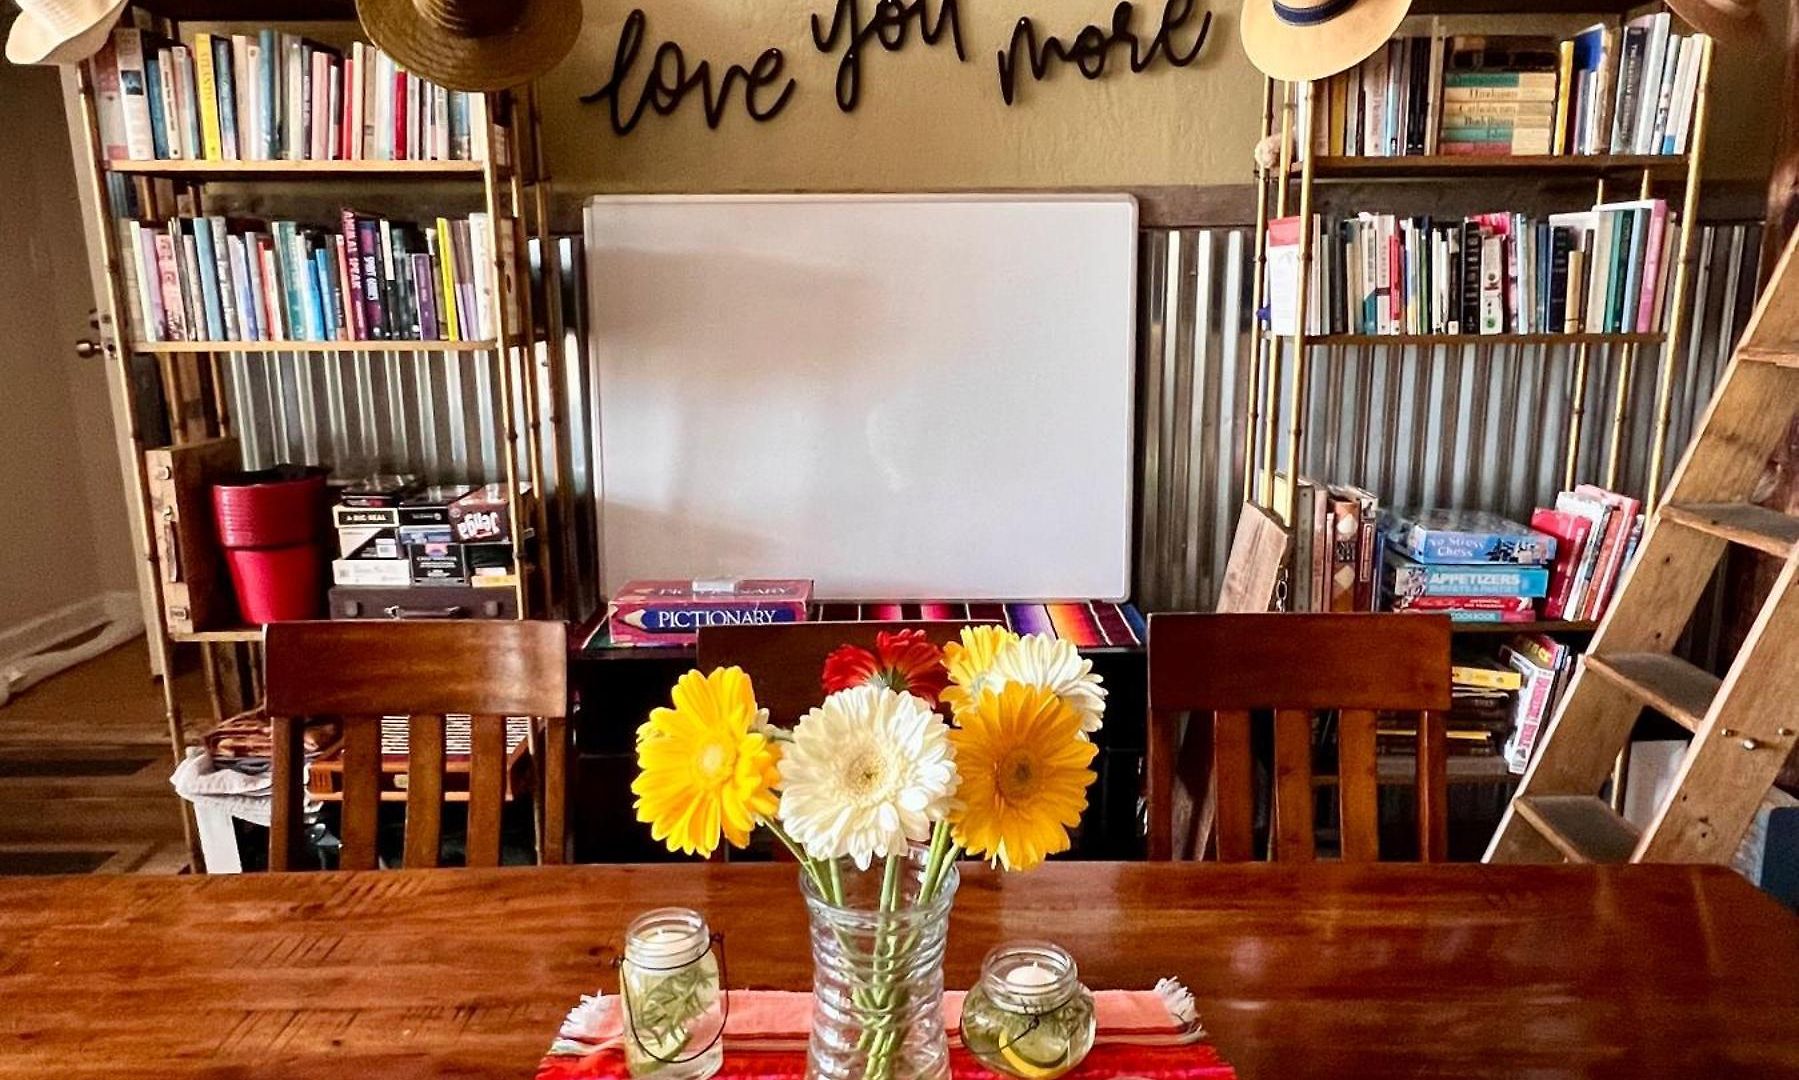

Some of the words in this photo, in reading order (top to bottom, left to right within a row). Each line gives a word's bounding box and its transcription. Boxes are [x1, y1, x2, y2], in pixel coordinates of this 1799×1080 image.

[579, 8, 796, 136] love
[811, 0, 967, 113] you
[997, 0, 1213, 105] more
[1437, 545, 1474, 557] Chess
[1430, 572, 1520, 585] APPETIZERS
[658, 610, 776, 628] PICTIONARY
